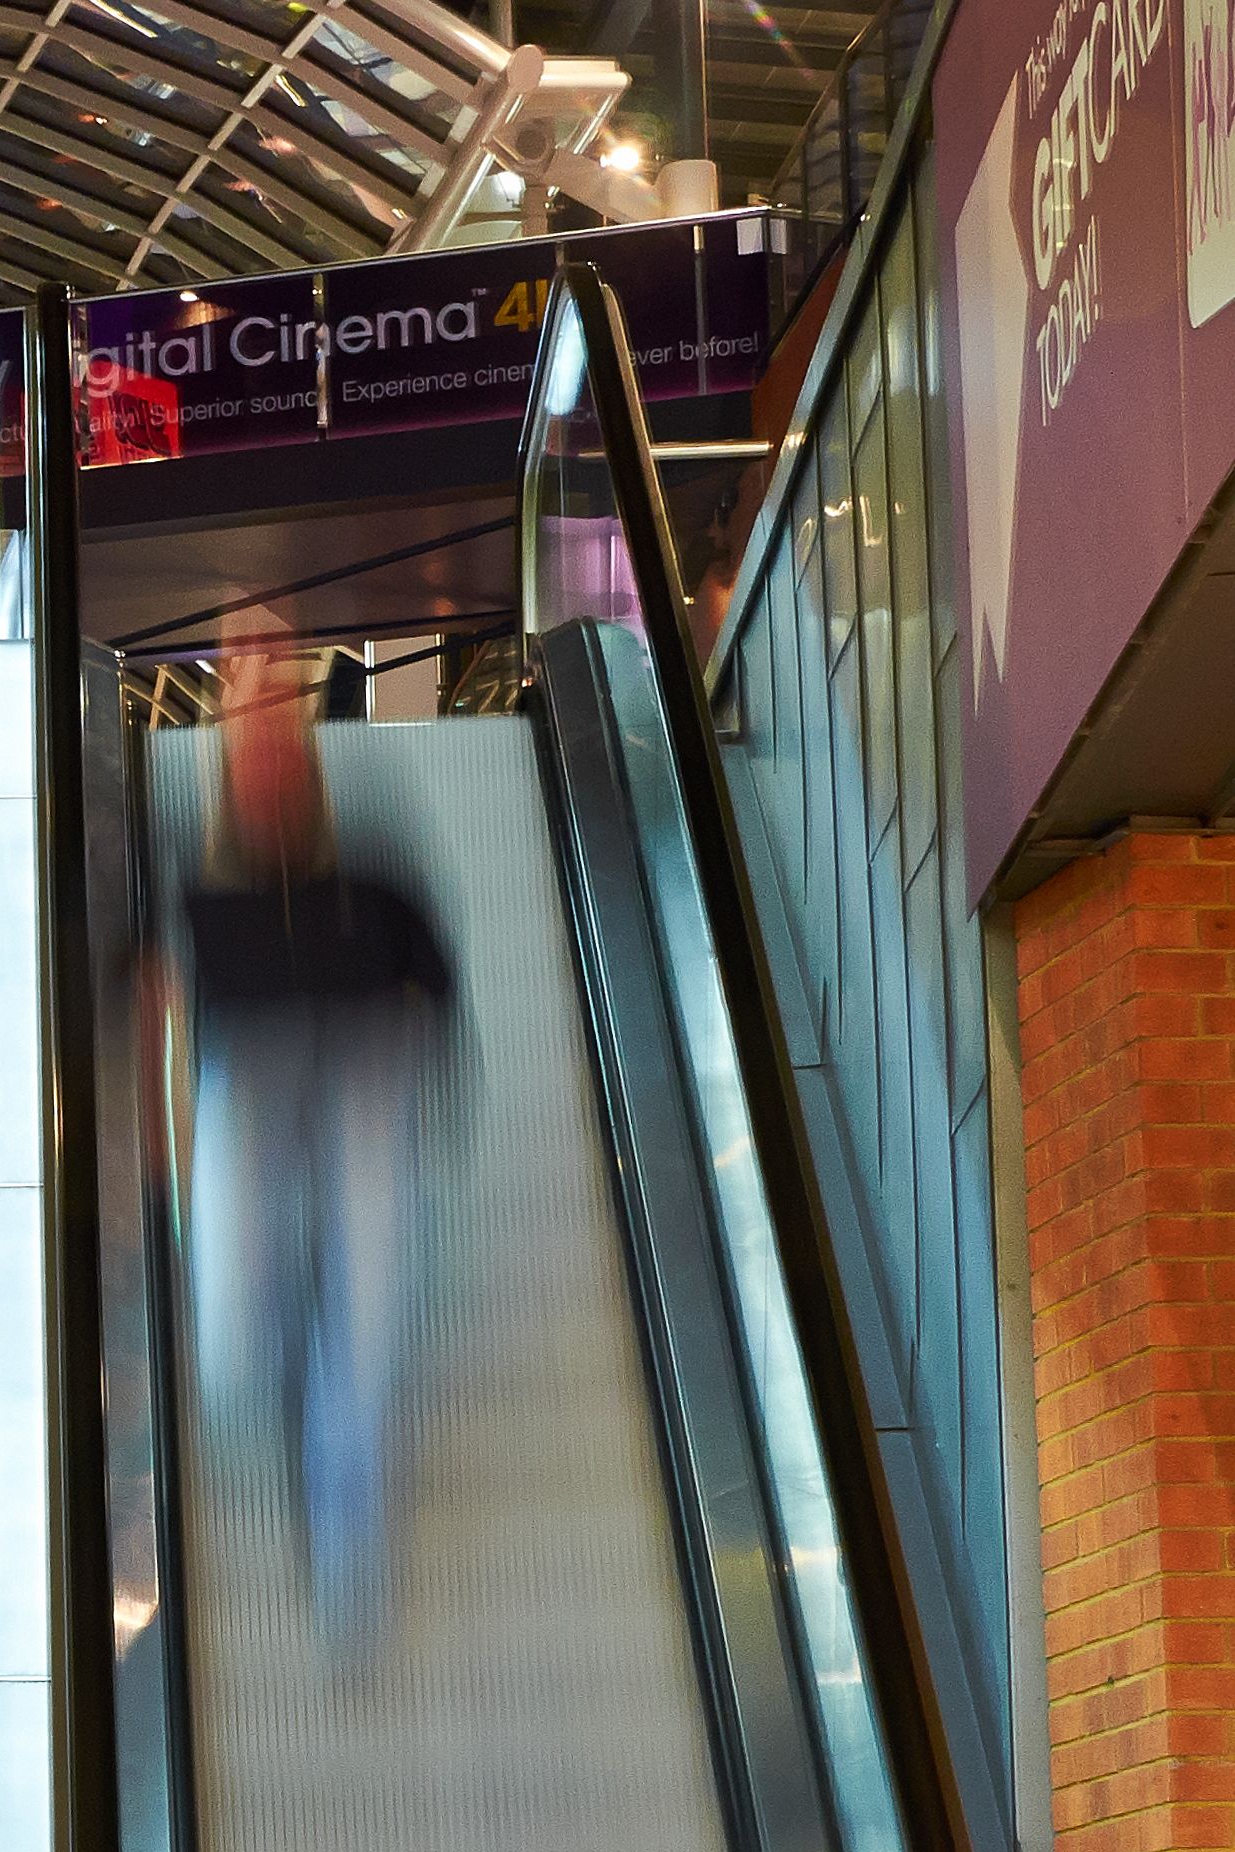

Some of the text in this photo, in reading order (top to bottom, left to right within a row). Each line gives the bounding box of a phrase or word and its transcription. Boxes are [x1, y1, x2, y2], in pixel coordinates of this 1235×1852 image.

[72, 324, 214, 399] igital
[1036, 214, 1099, 426] TODAY!
[150, 397, 245, 427] Superior
[342, 366, 467, 404] Experience
[474, 362, 535, 387] cinem
[679, 330, 759, 362] before!
